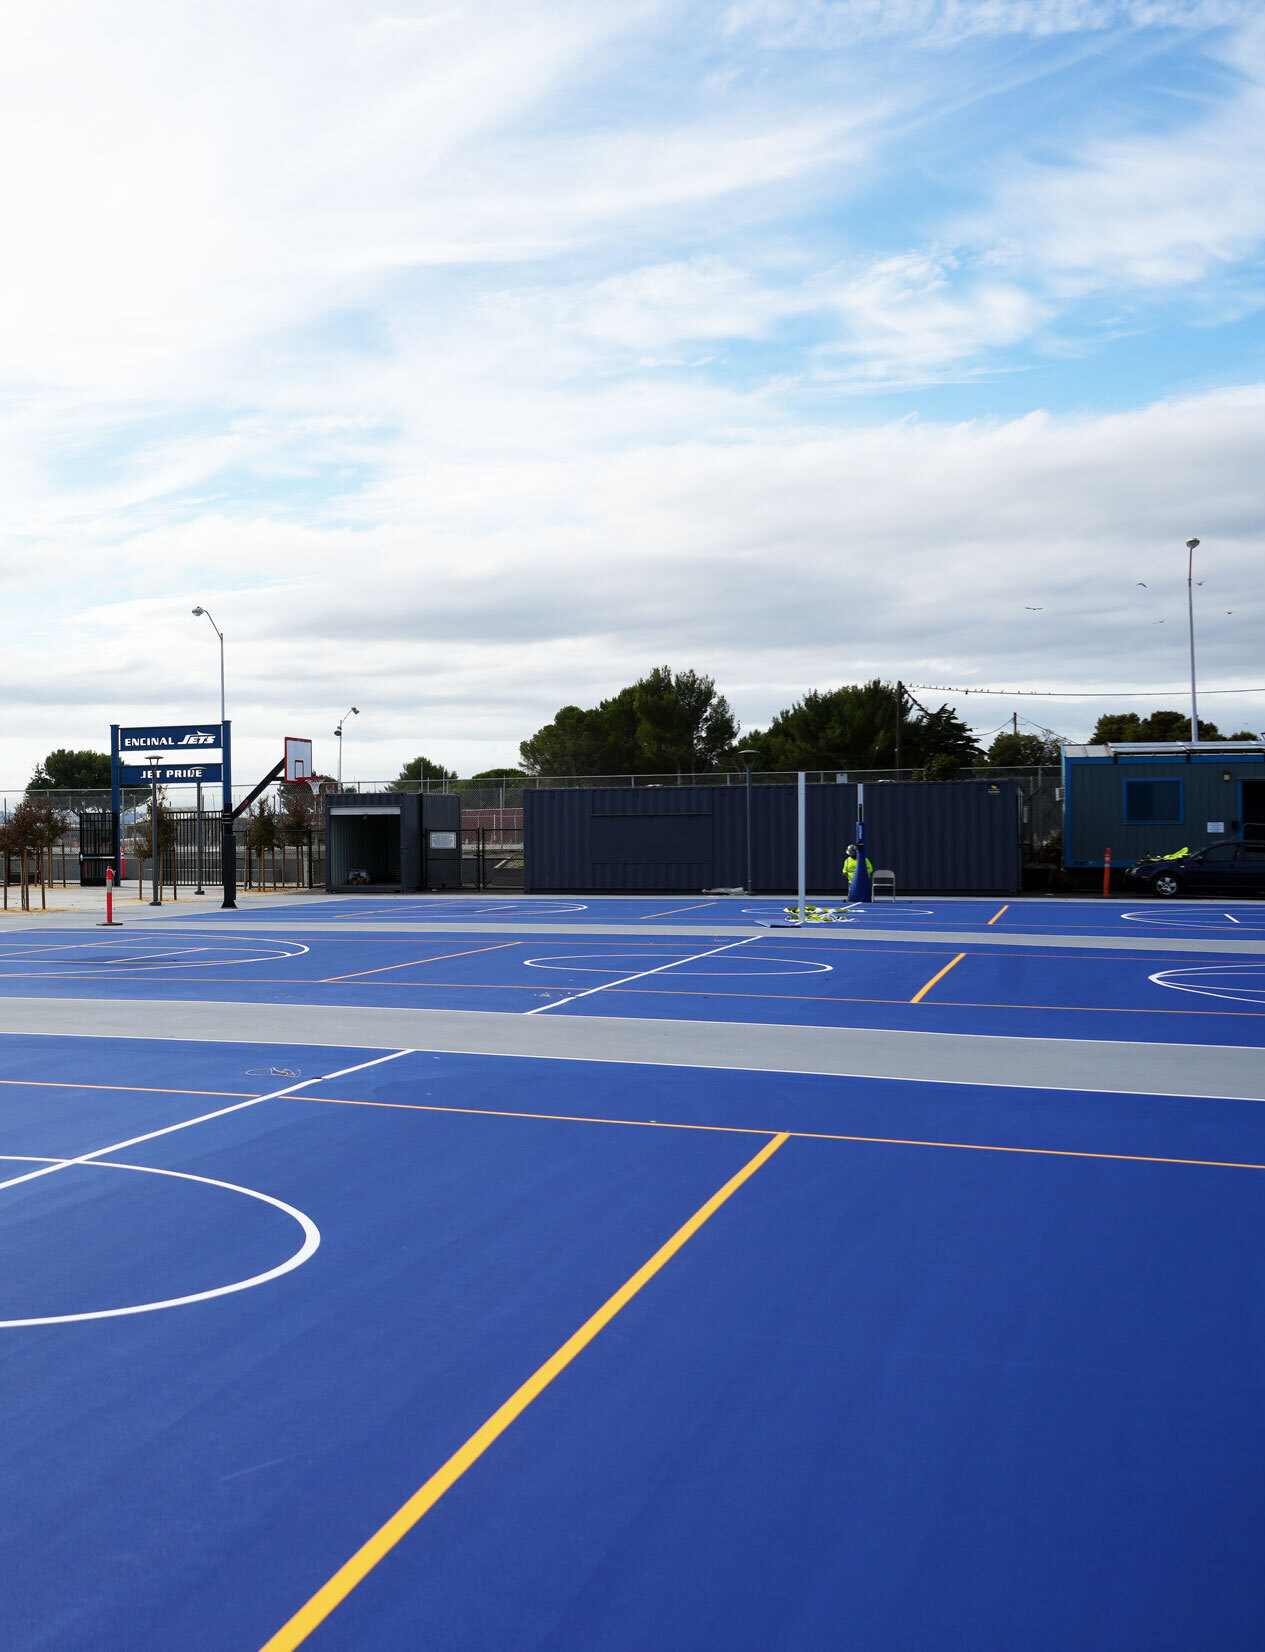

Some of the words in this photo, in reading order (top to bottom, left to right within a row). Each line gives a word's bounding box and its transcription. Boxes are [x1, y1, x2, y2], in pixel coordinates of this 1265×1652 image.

[124, 737, 175, 746] ENCINAL
[177, 730, 216, 744] JETS
[140, 770, 162, 779] JET
[166, 769, 203, 778] PRIDE
